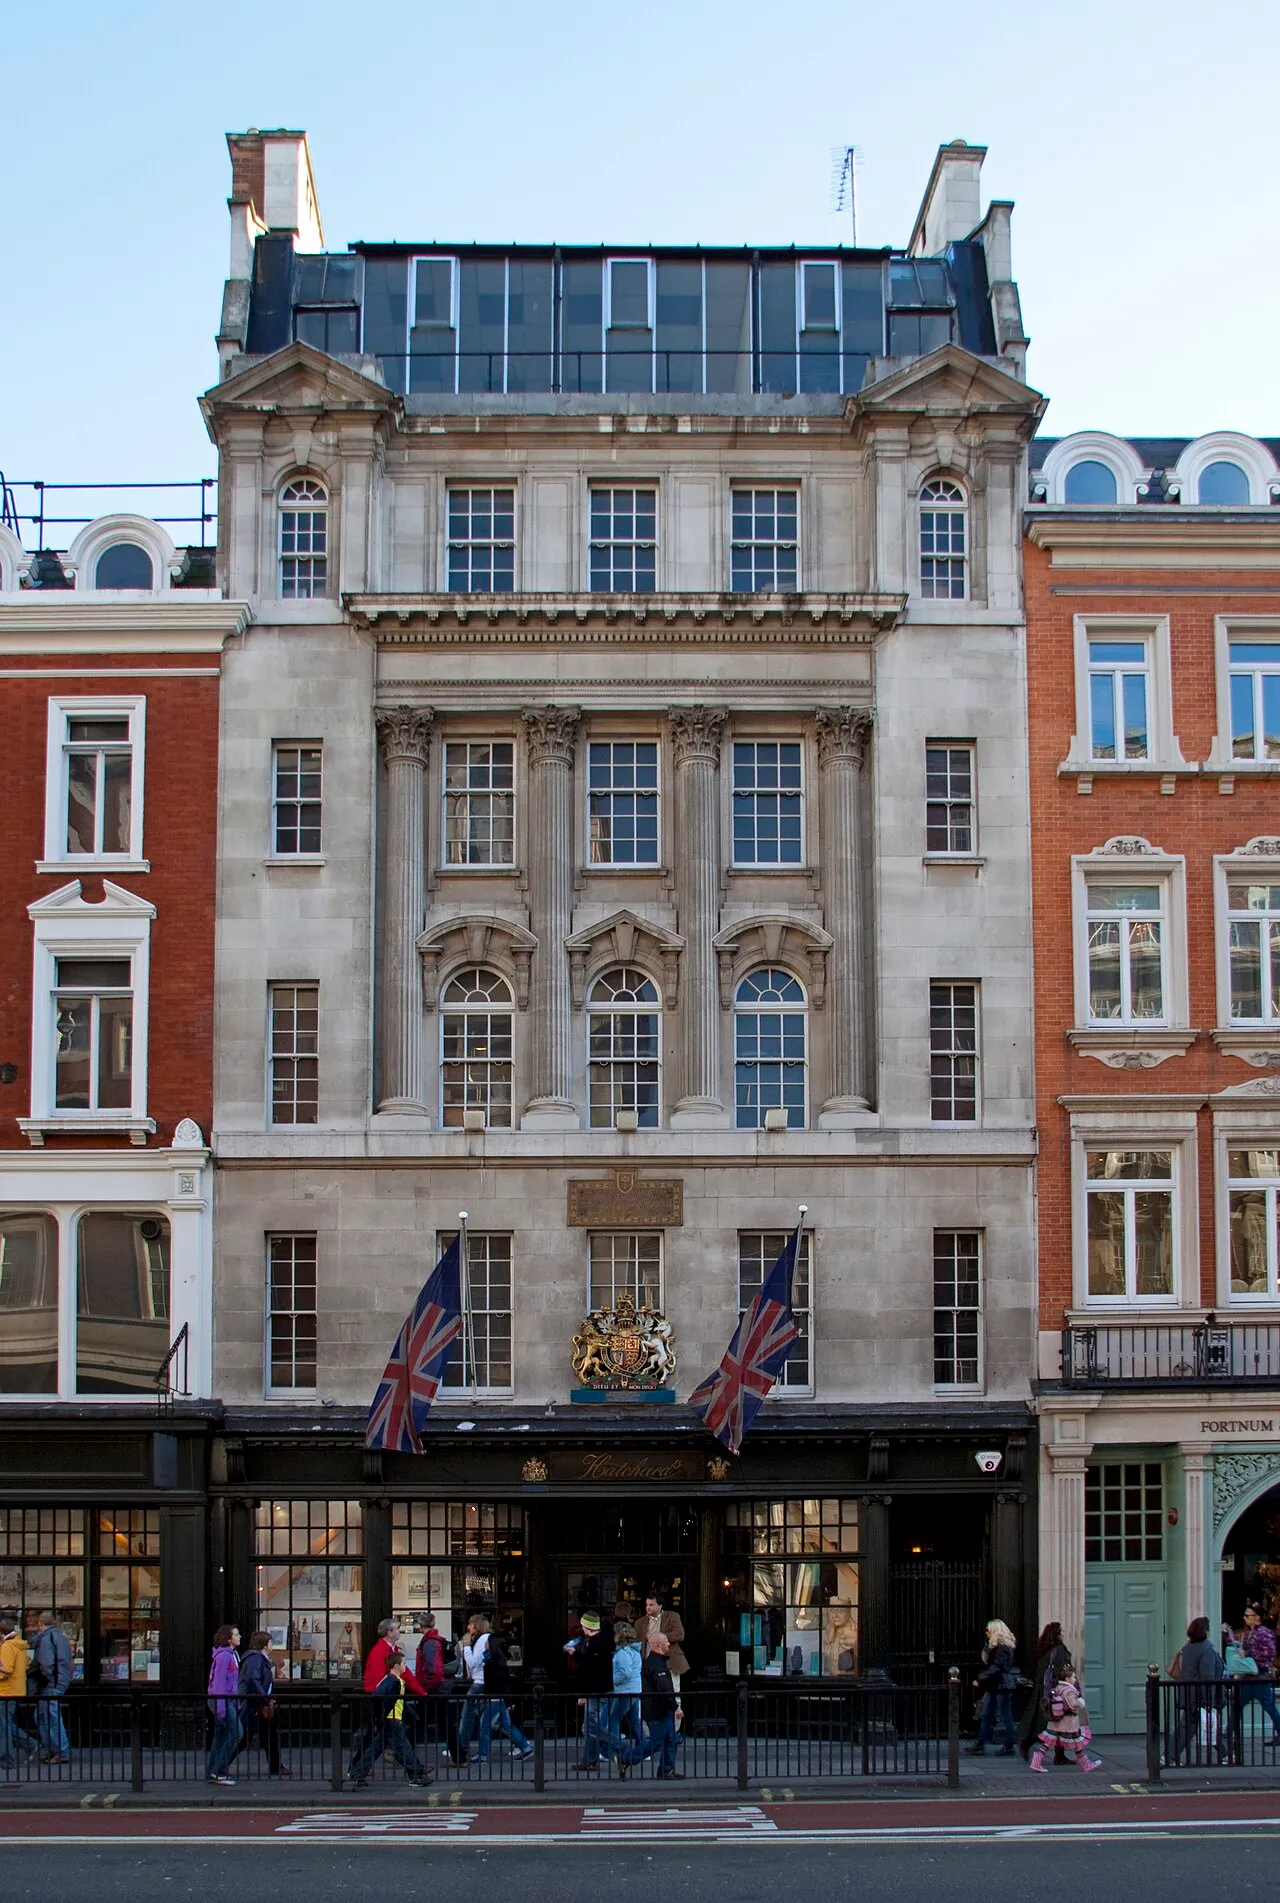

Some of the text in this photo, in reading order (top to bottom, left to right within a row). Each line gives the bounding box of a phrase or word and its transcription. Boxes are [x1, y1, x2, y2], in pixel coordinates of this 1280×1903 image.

[1200, 1420, 1274, 1433] FORTNUM
[275, 1812, 479, 1831] BUS
[580, 1807, 779, 1833] LANE
